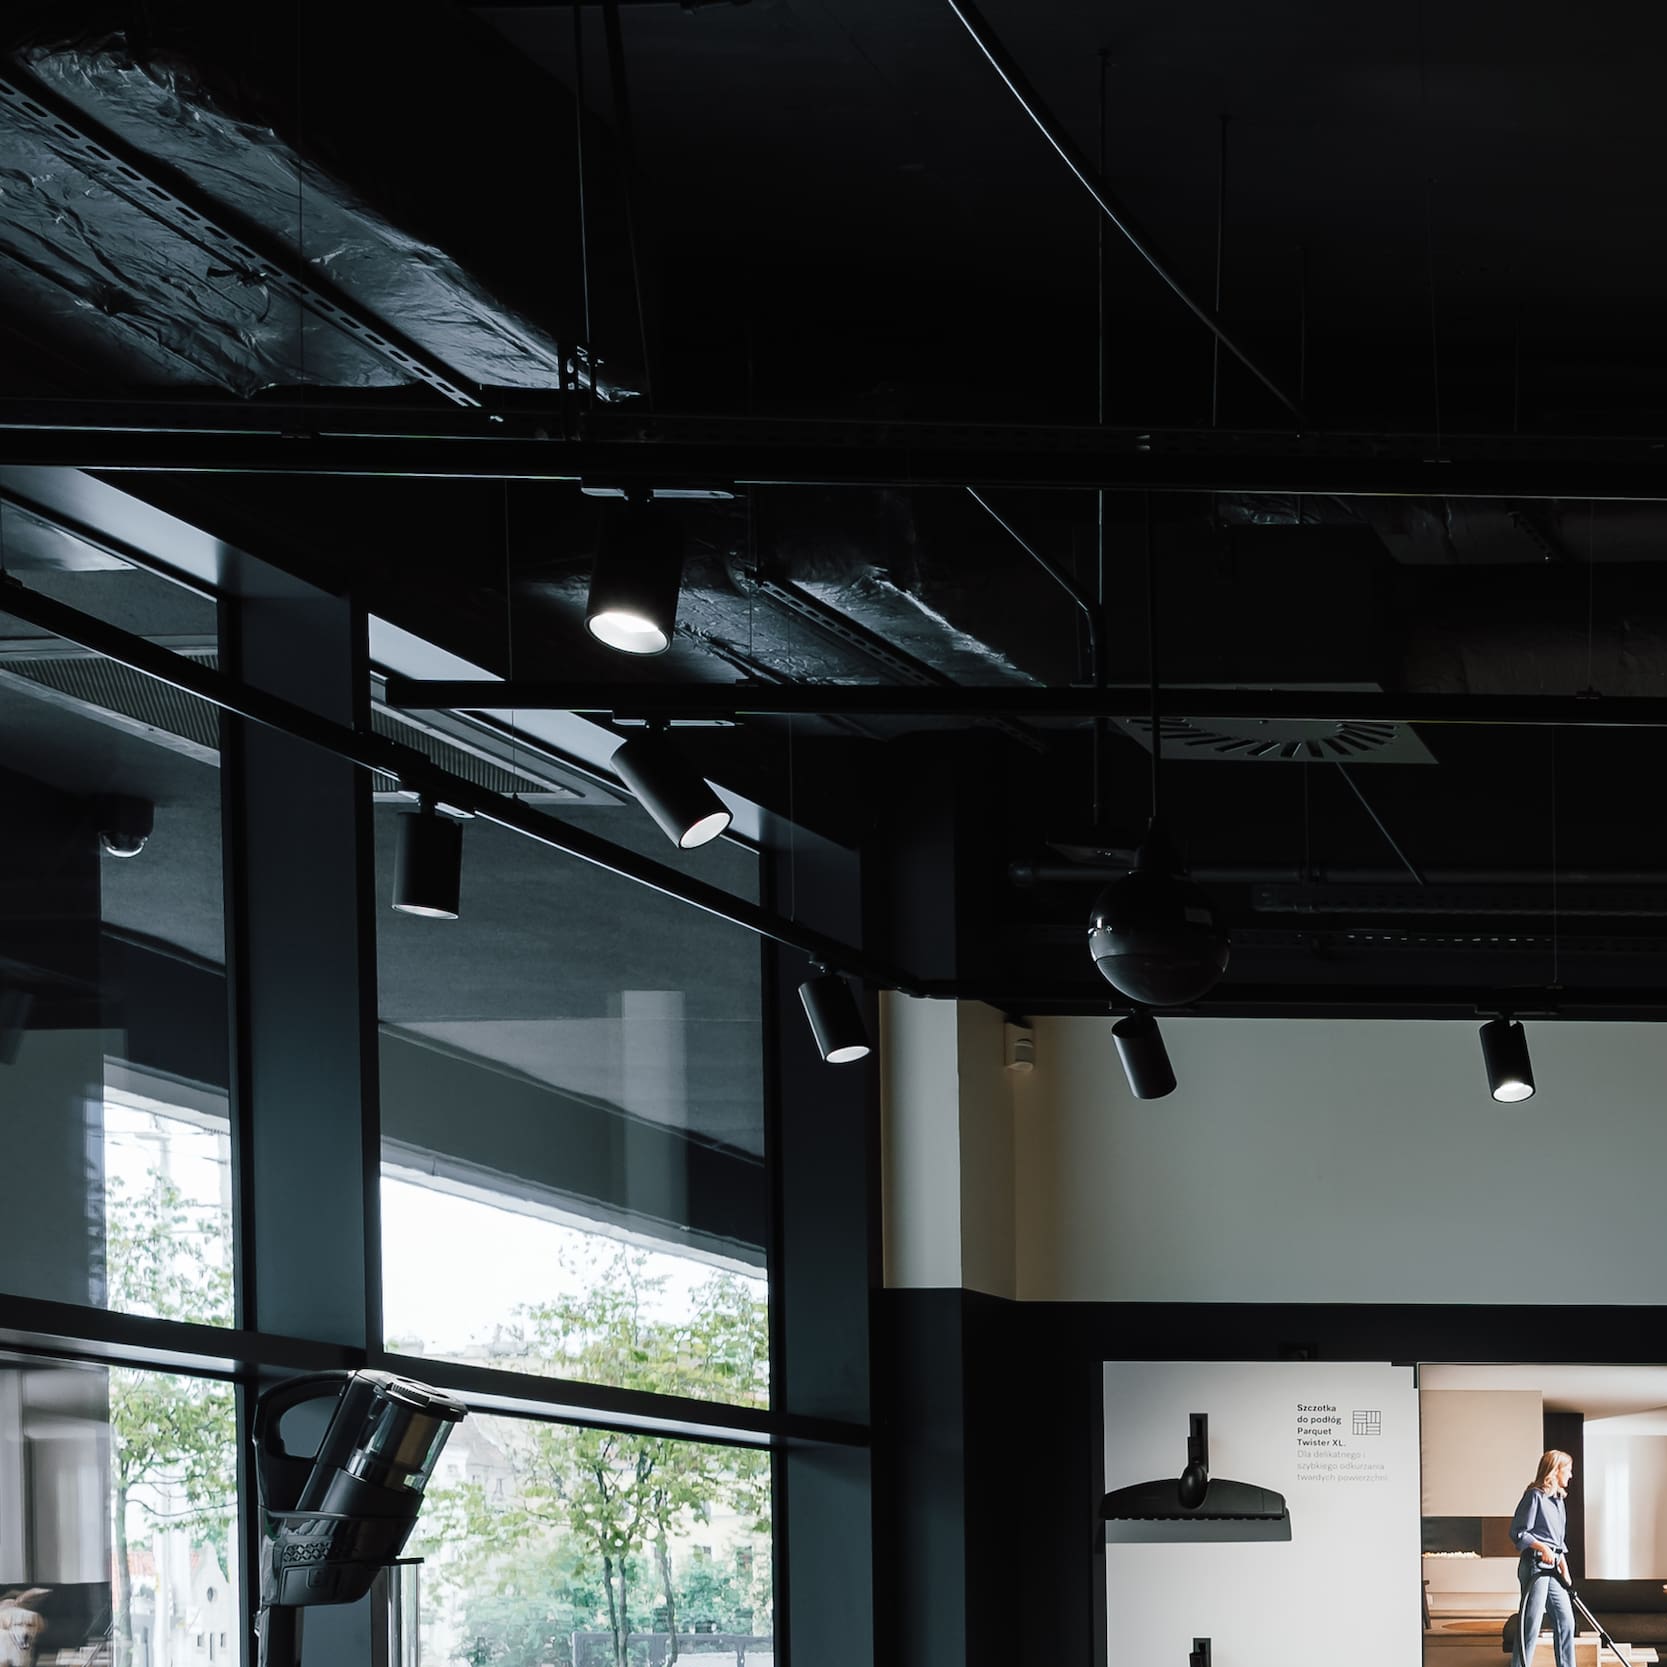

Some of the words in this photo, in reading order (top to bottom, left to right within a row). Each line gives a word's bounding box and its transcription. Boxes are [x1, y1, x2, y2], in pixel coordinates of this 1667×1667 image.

[1297, 1404, 1336, 1412] Szczotka
[1311, 1416, 1342, 1425] podłóg
[1297, 1428, 1332, 1436] Parquet
[1297, 1450, 1311, 1458] Dla
[1314, 1450, 1360, 1460] delikatnego
[1297, 1463, 1337, 1471] szybkiego
[1297, 1475, 1335, 1483] twardych
